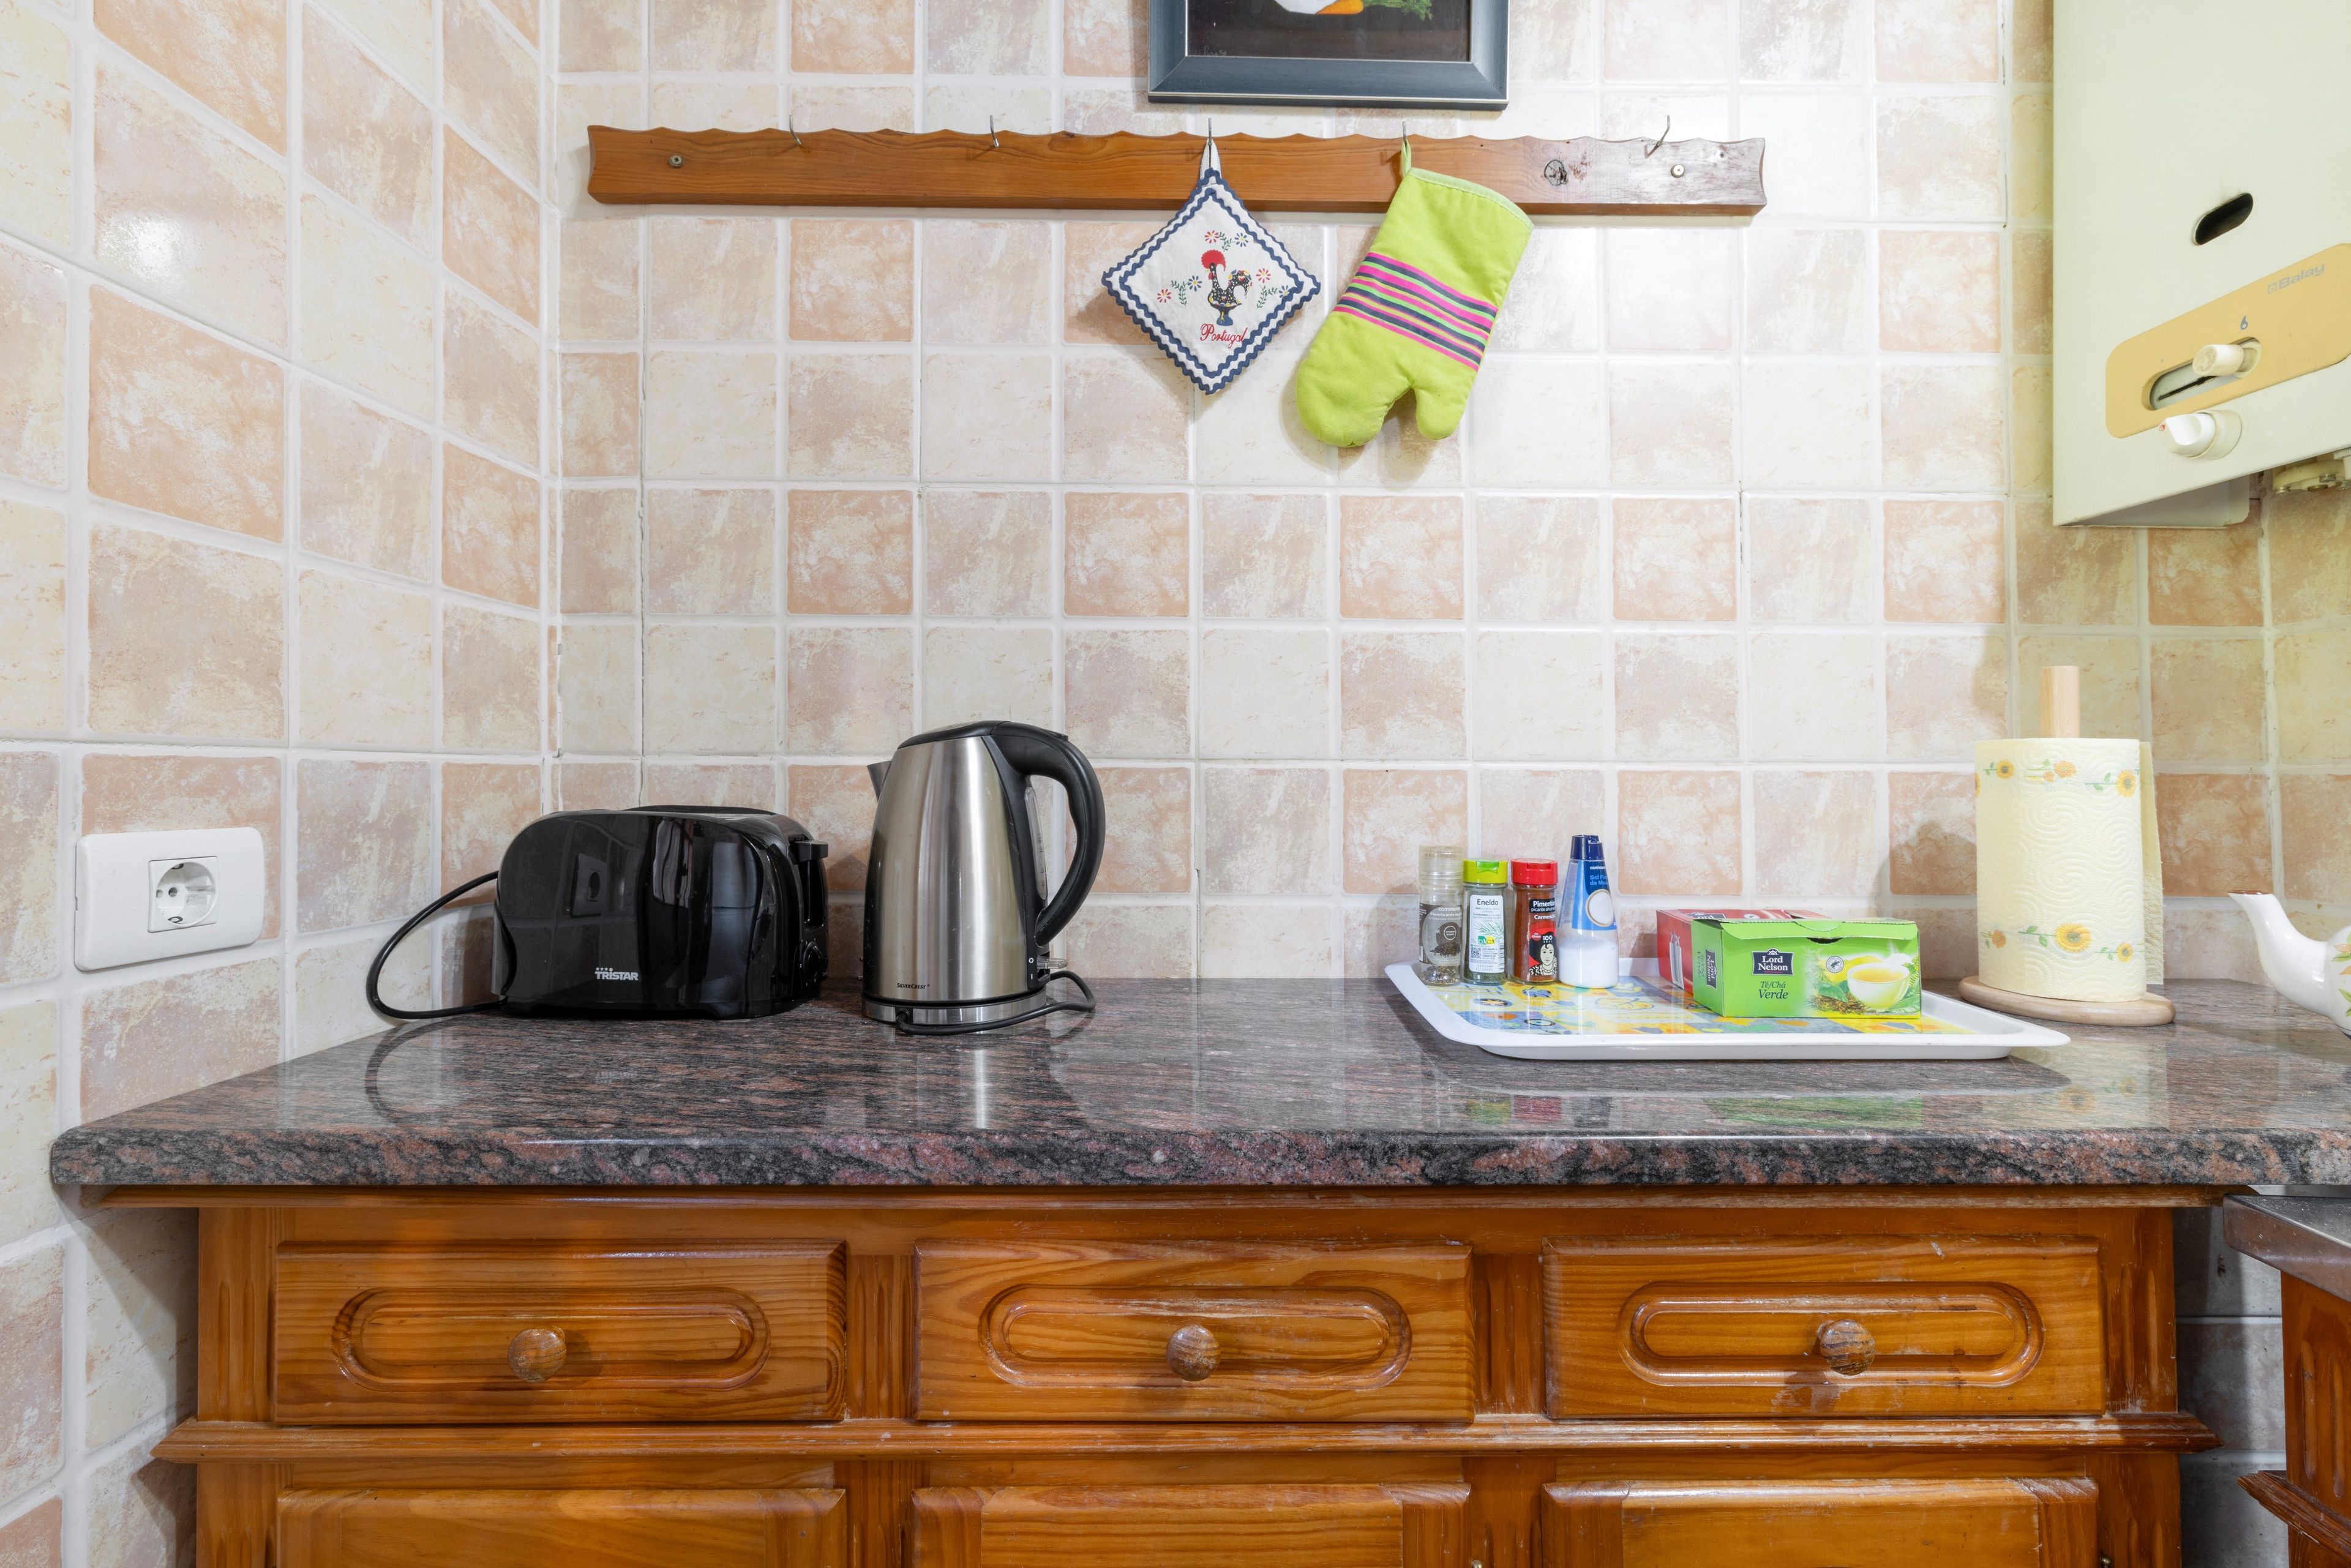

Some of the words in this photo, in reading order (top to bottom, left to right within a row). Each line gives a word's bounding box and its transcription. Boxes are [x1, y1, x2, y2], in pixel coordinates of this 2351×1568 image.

[2279, 263, 2325, 289] Balay
[1200, 323, 1248, 348] Portugal
[1758, 989, 1788, 999] Verde
